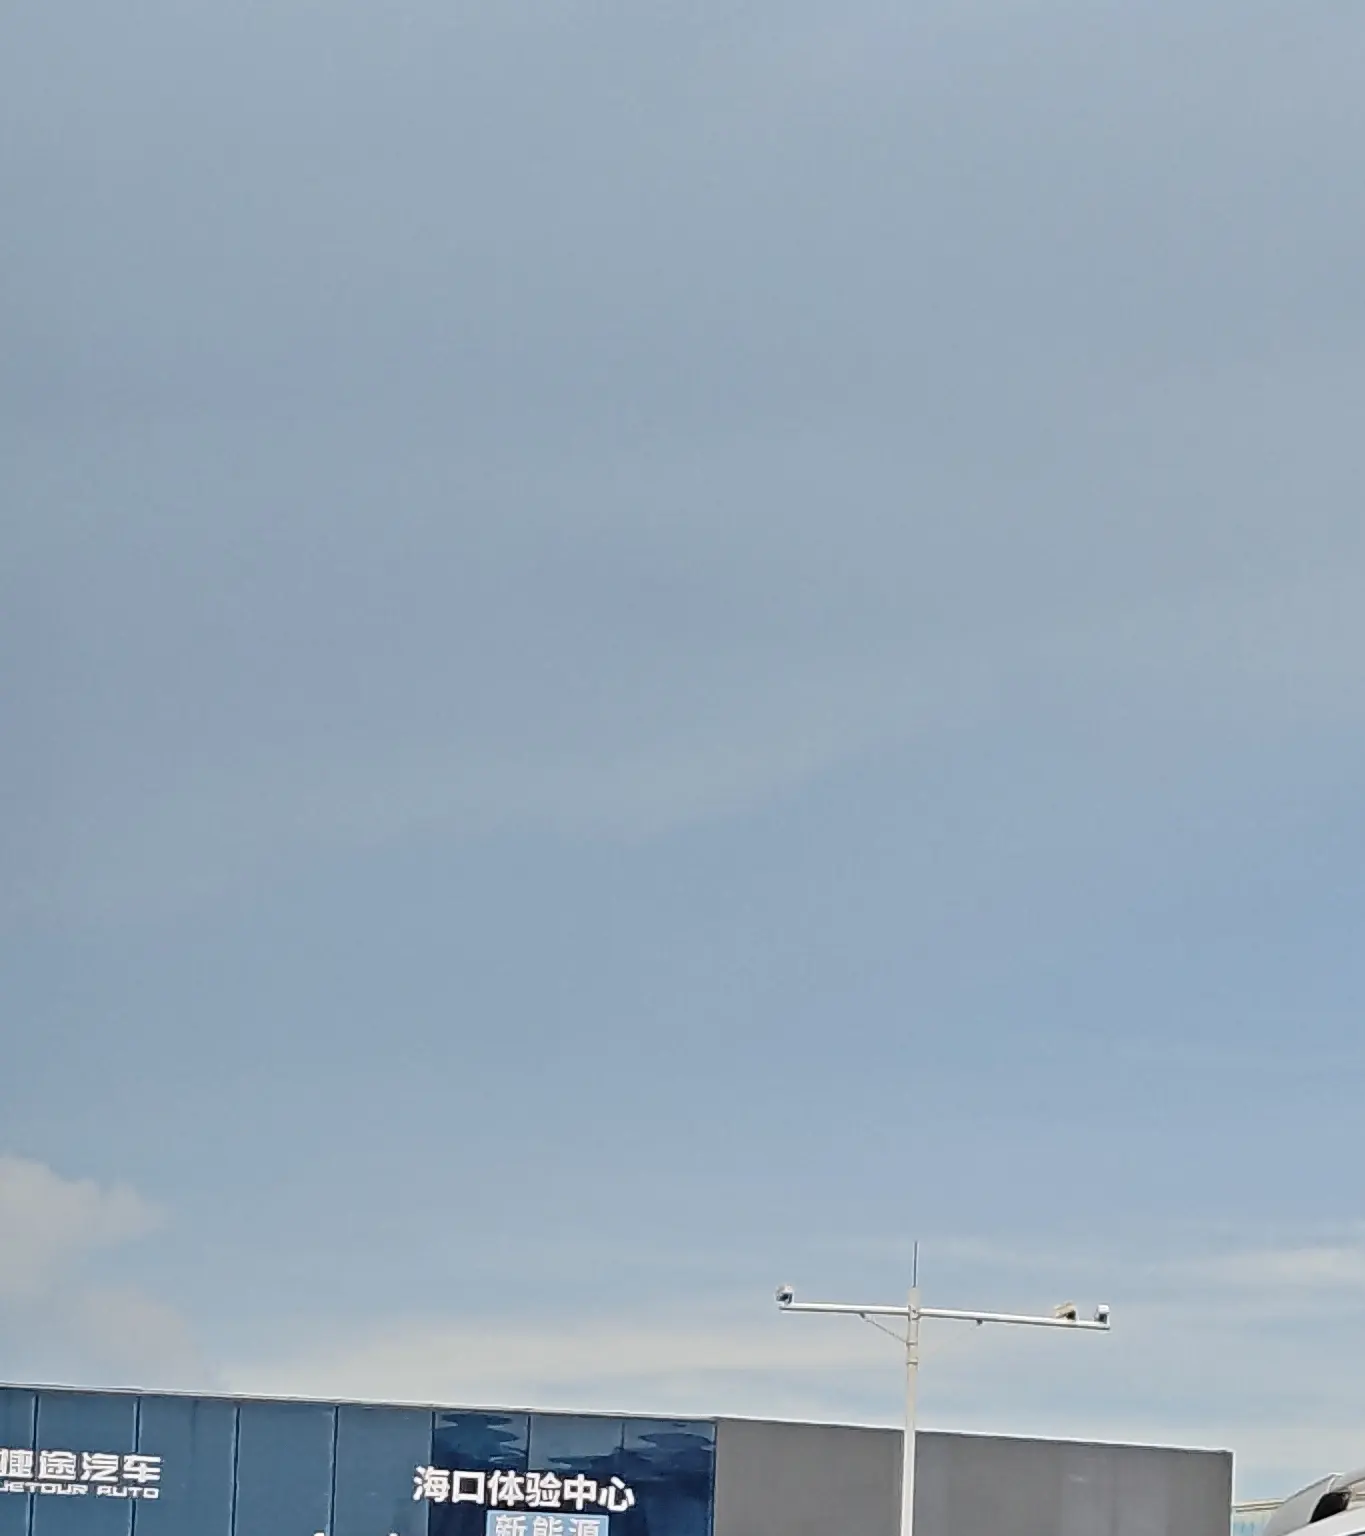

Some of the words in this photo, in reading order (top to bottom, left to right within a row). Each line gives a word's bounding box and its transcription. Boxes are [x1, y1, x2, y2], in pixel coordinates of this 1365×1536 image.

[0, 1480, 89, 1496] JETOUR
[96, 1484, 160, 1499] AUTO
[412, 1465, 636, 1512] 海口体验中心
